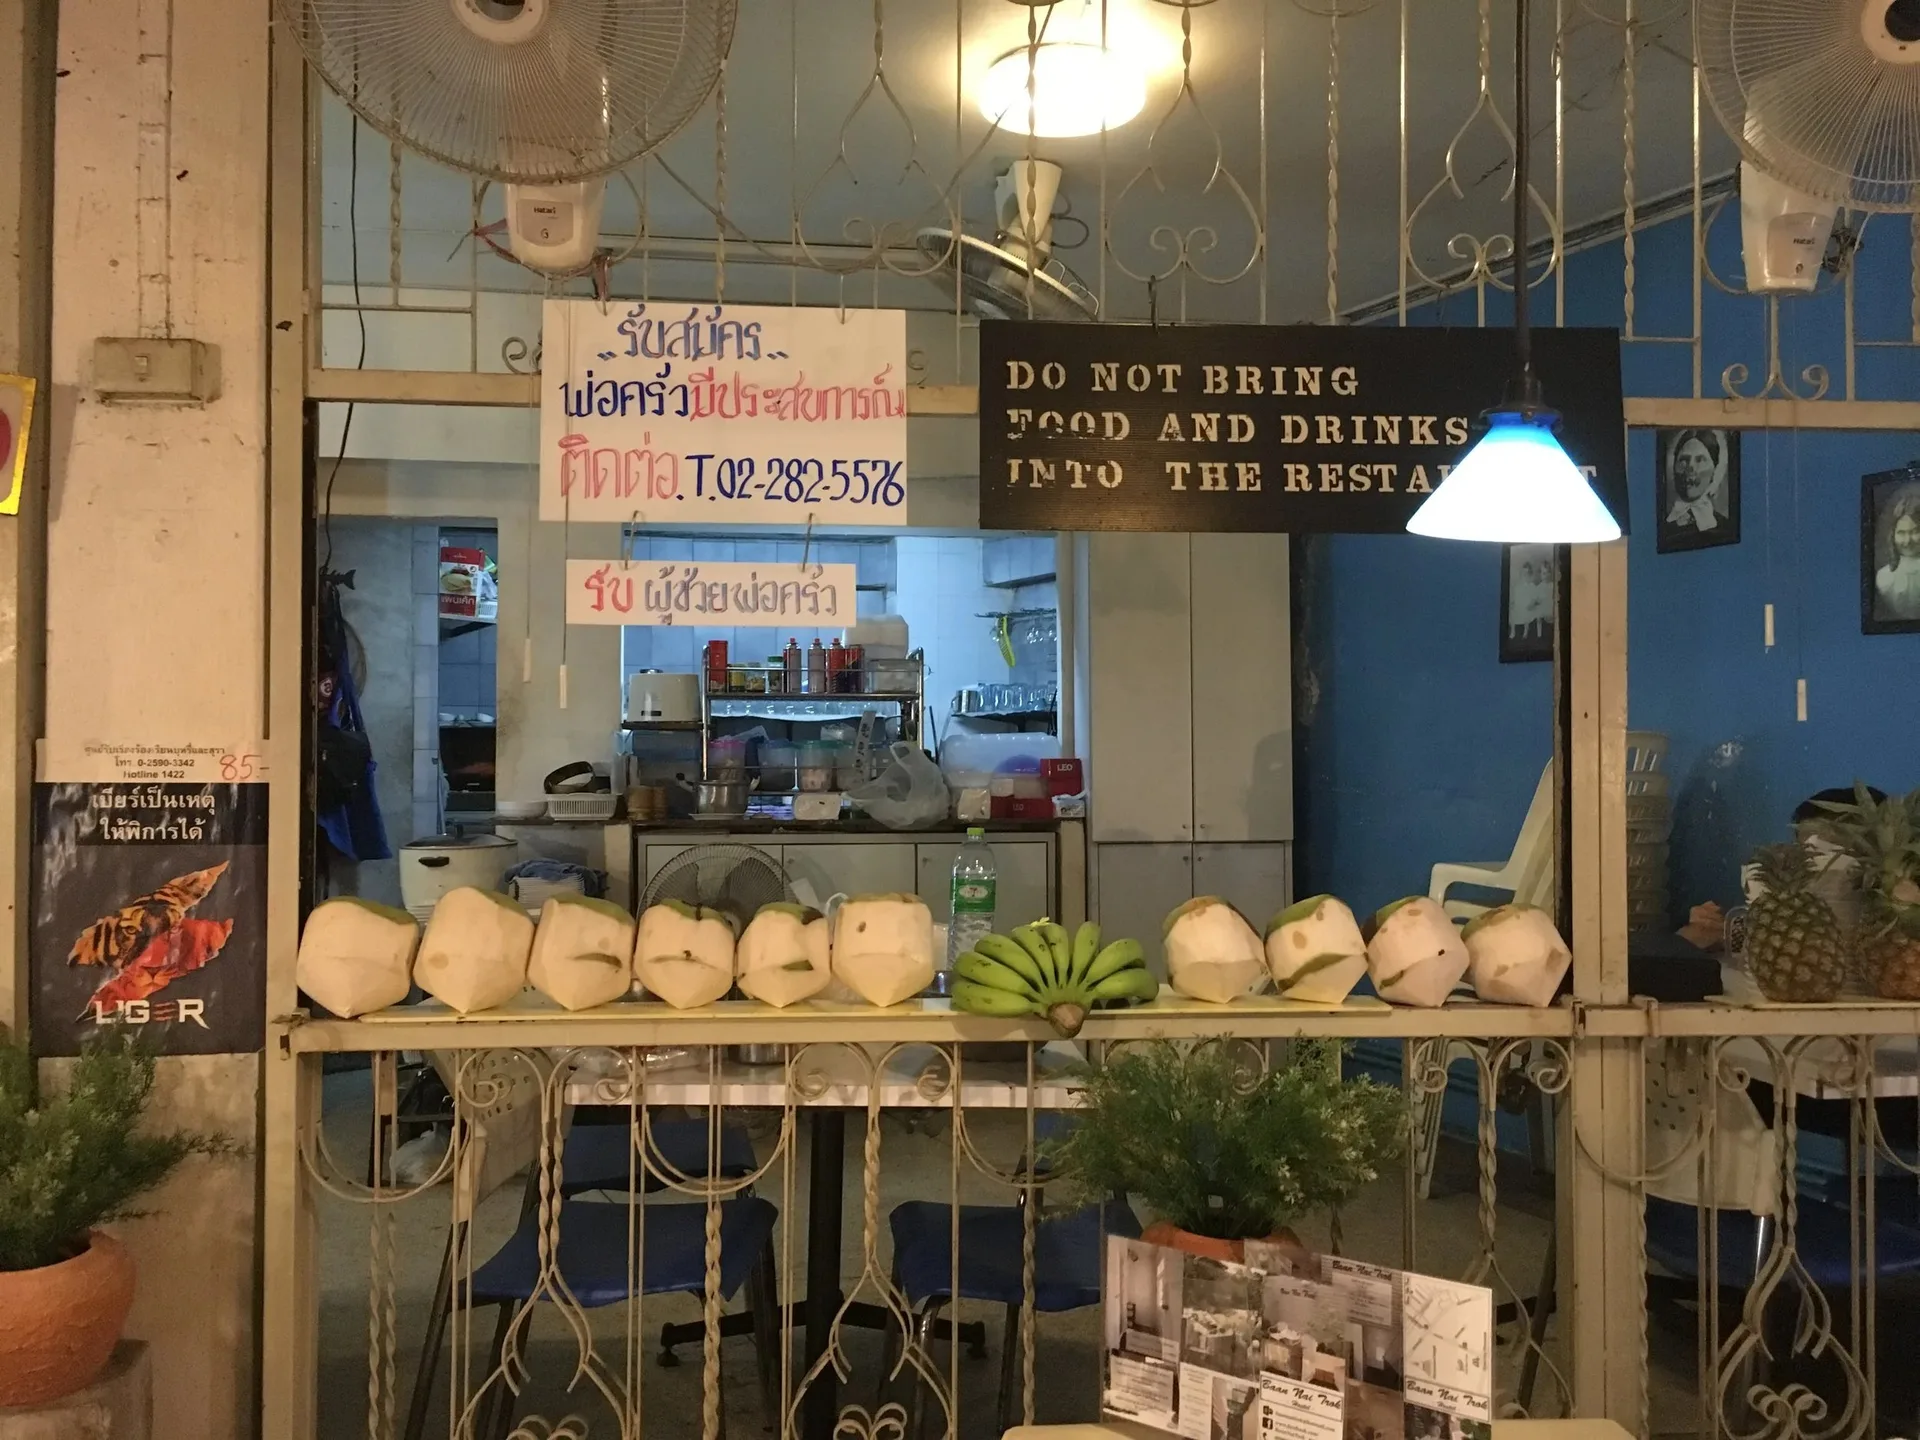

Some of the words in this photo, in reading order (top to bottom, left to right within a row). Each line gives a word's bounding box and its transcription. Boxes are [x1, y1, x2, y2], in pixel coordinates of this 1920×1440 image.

[1006, 361, 1066, 391] DO
[1091, 362, 1181, 394] NOT
[1202, 365, 1359, 396] BRING
[1006, 408, 1130, 441] FOOD
[1156, 414, 1256, 443] AND
[1280, 415, 1468, 445] DRINKS
[1006, 459, 1123, 488] INTO
[1165, 461, 1262, 491] THE
[584, 564, 634, 613] รับ
[137, 759, 195, 767] 0-2590-3342
[162, 770, 185, 779] 1422
[100, 817, 206, 841] ให้พิการได้
[1262, 1379, 1288, 1395] Baan
[1292, 1387, 1314, 1402] Nai
[1317, 1393, 1342, 1410] Trok
[1406, 1380, 1434, 1396] Baan
[1437, 1388, 1459, 1403] Nai
[1462, 1394, 1488, 1411] Trok
